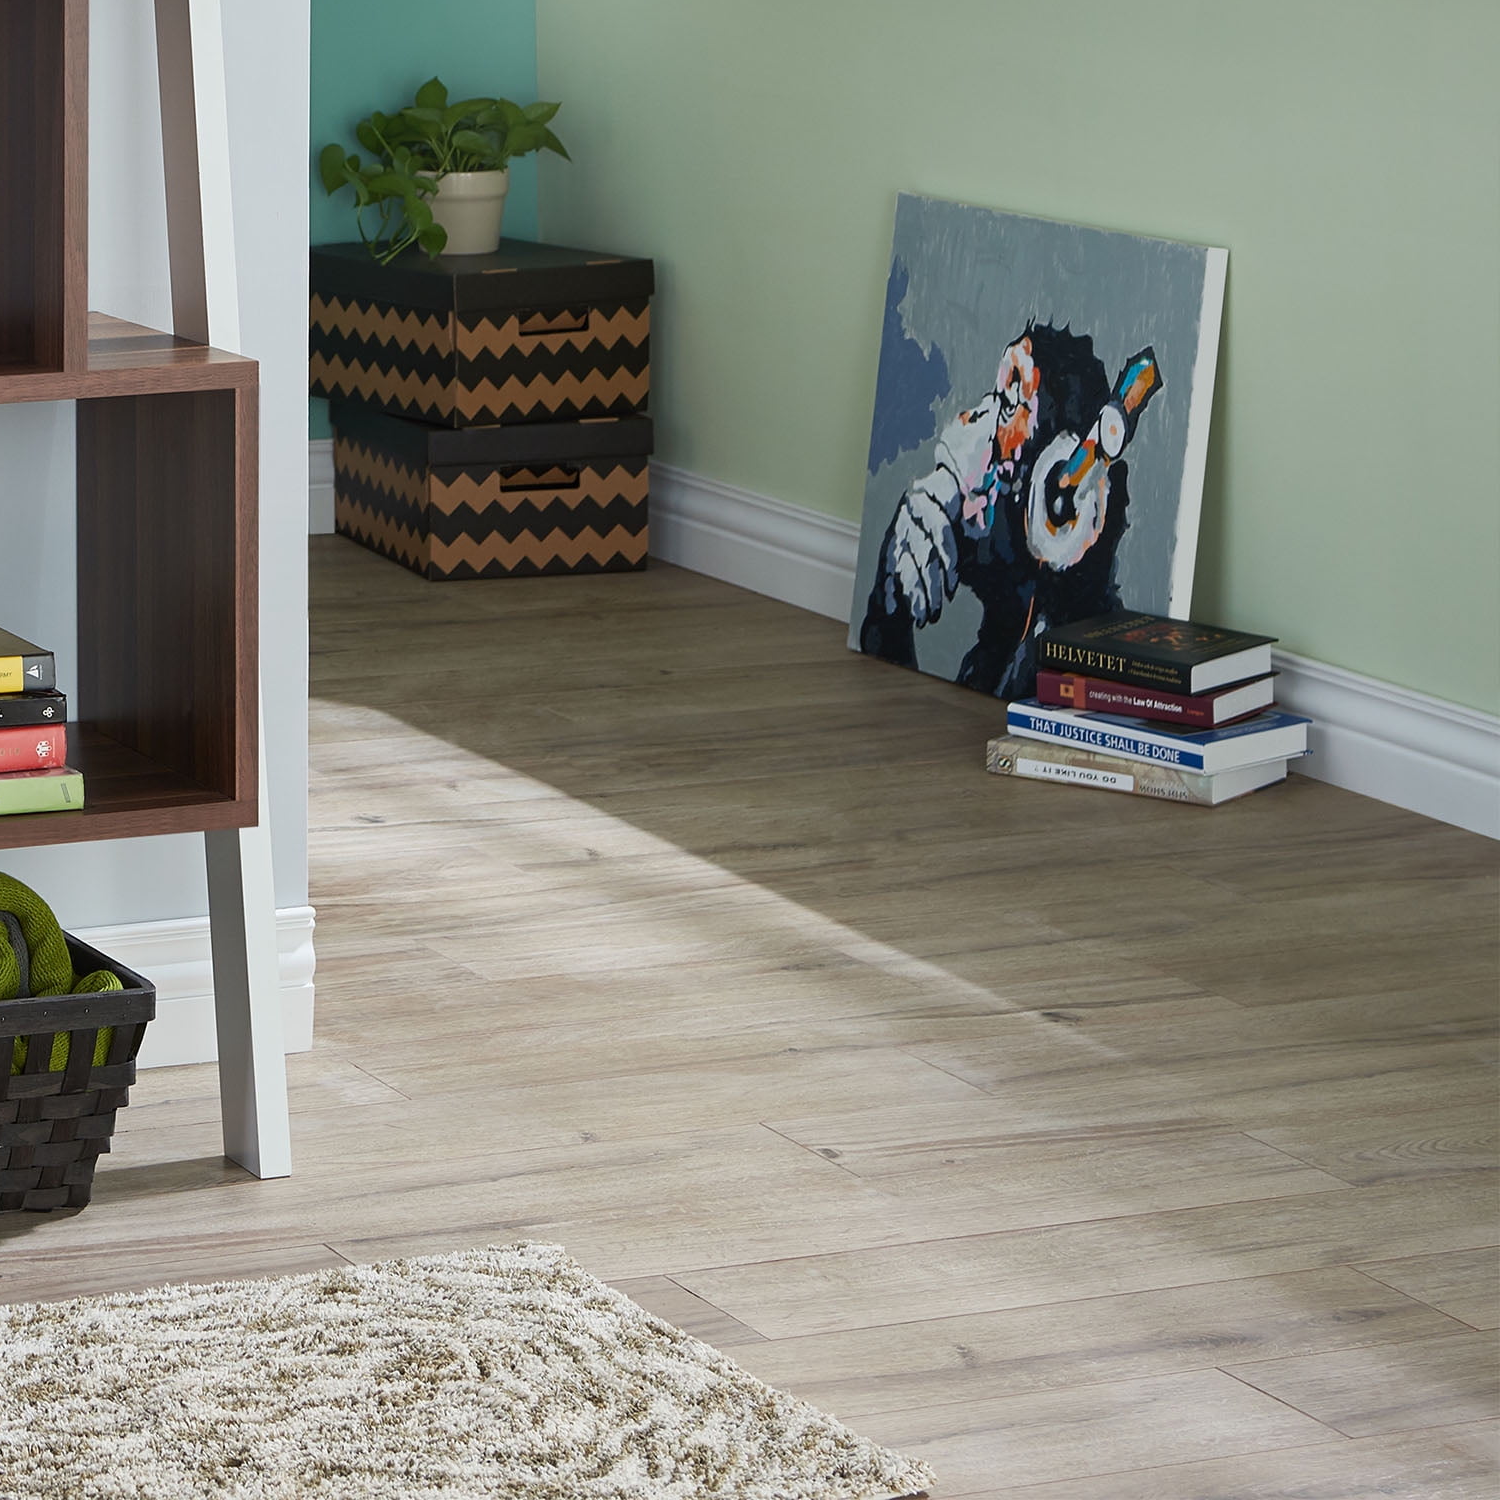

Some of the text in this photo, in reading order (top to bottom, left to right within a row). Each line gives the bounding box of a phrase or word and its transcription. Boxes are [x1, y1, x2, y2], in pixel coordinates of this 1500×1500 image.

[1046, 642, 1127, 673] HELVETET
[1089, 690, 1111, 703] creating
[1112, 693, 1124, 703] with
[1123, 695, 1133, 705] the
[1133, 697, 1146, 706] Law
[1154, 700, 1182, 713] Attraction
[1030, 717, 1180, 763] THAT JUSTICE SHALL BE DONE
[1042, 766, 1052, 774] IT
[1054, 768, 1077, 778] LIKE
[1078, 772, 1099, 781] YOU
[1102, 776, 1117, 784] DO
